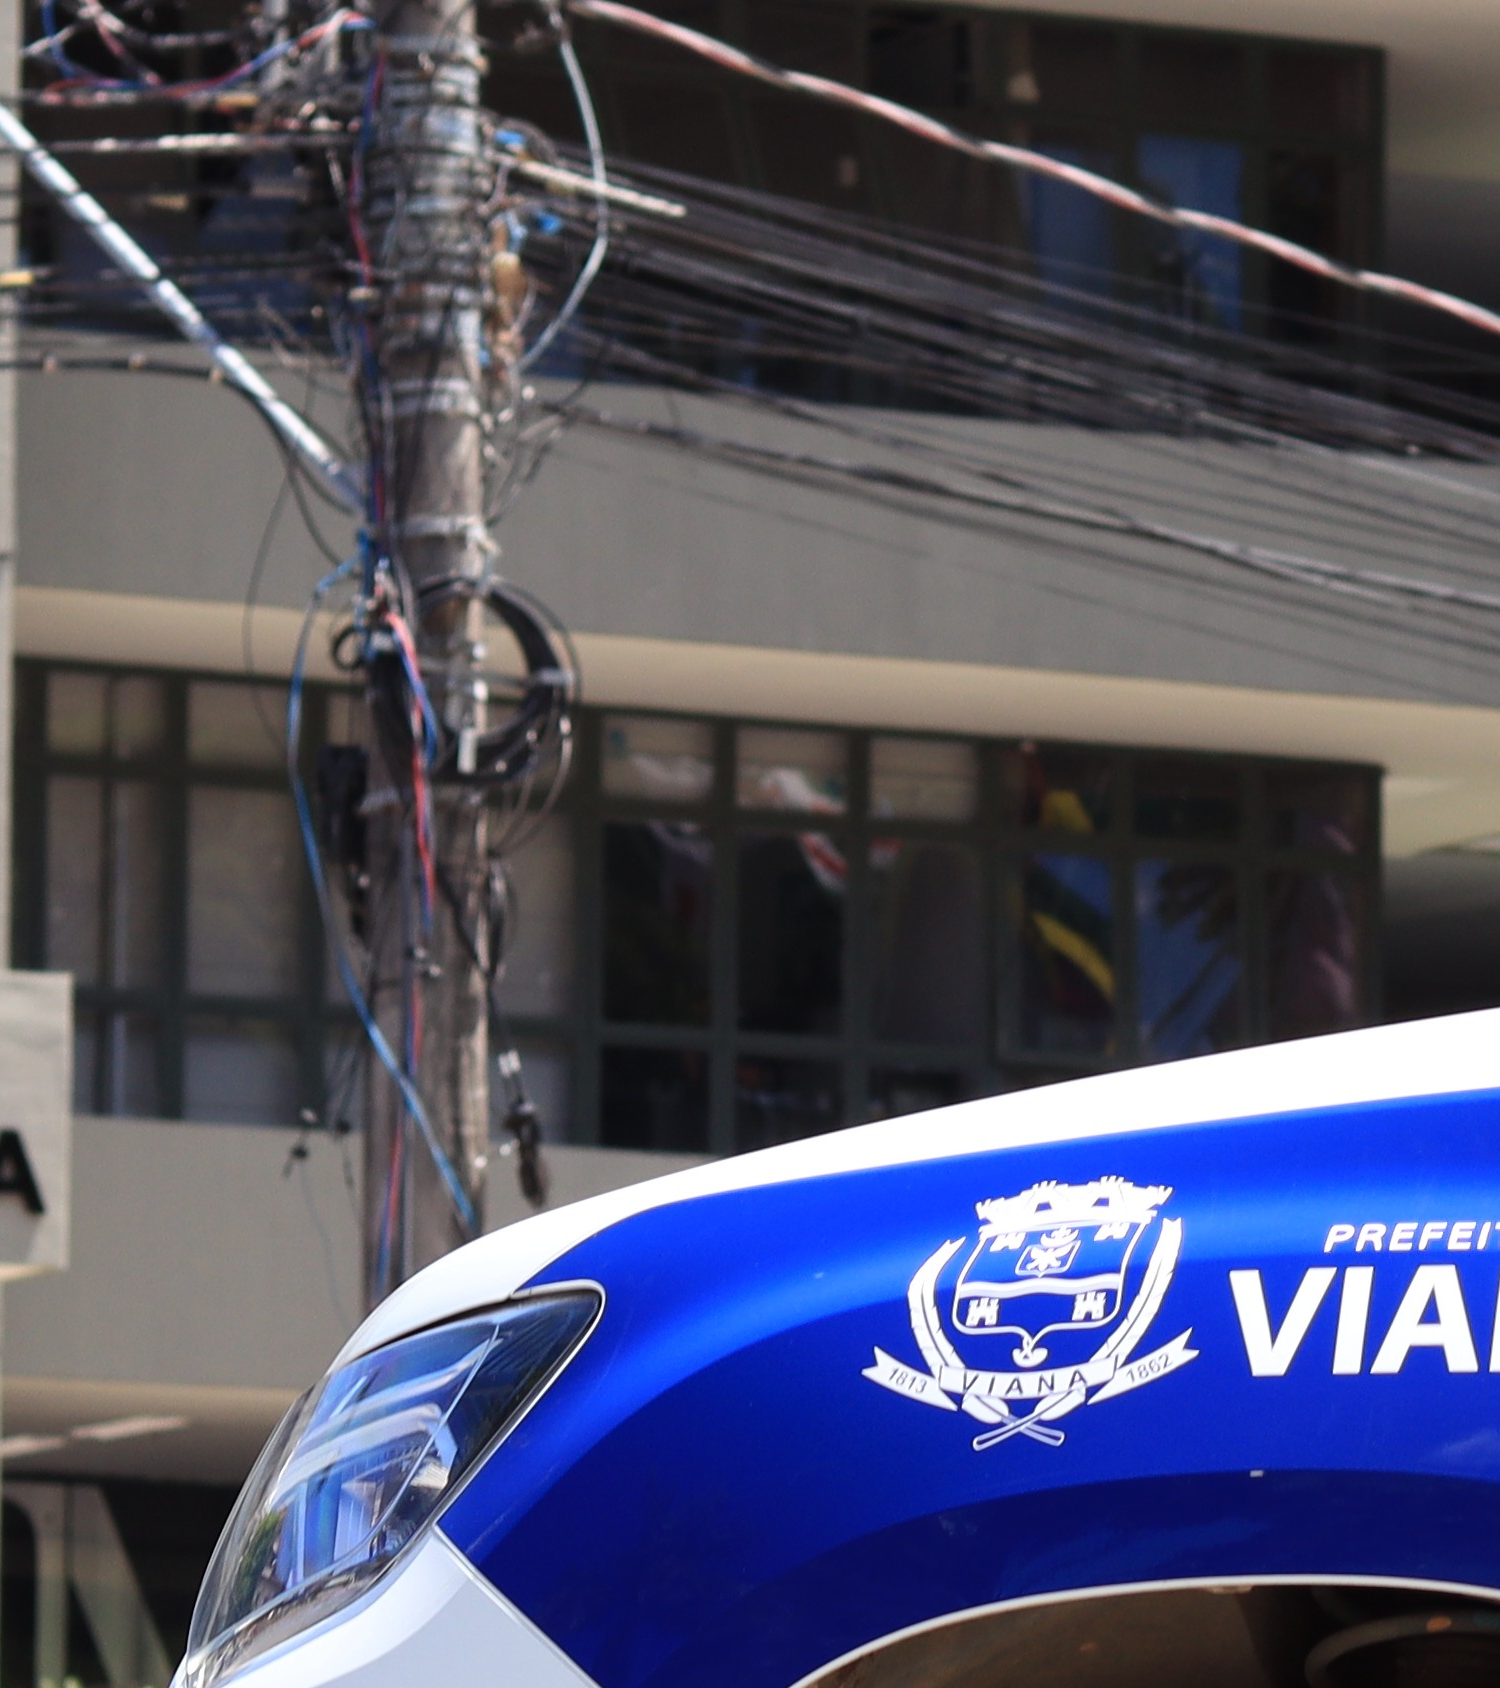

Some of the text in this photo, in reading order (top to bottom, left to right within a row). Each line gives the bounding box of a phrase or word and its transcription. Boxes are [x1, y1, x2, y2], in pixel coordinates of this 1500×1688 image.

[888, 1353, 1174, 1396] 1813 VIANA 1862
